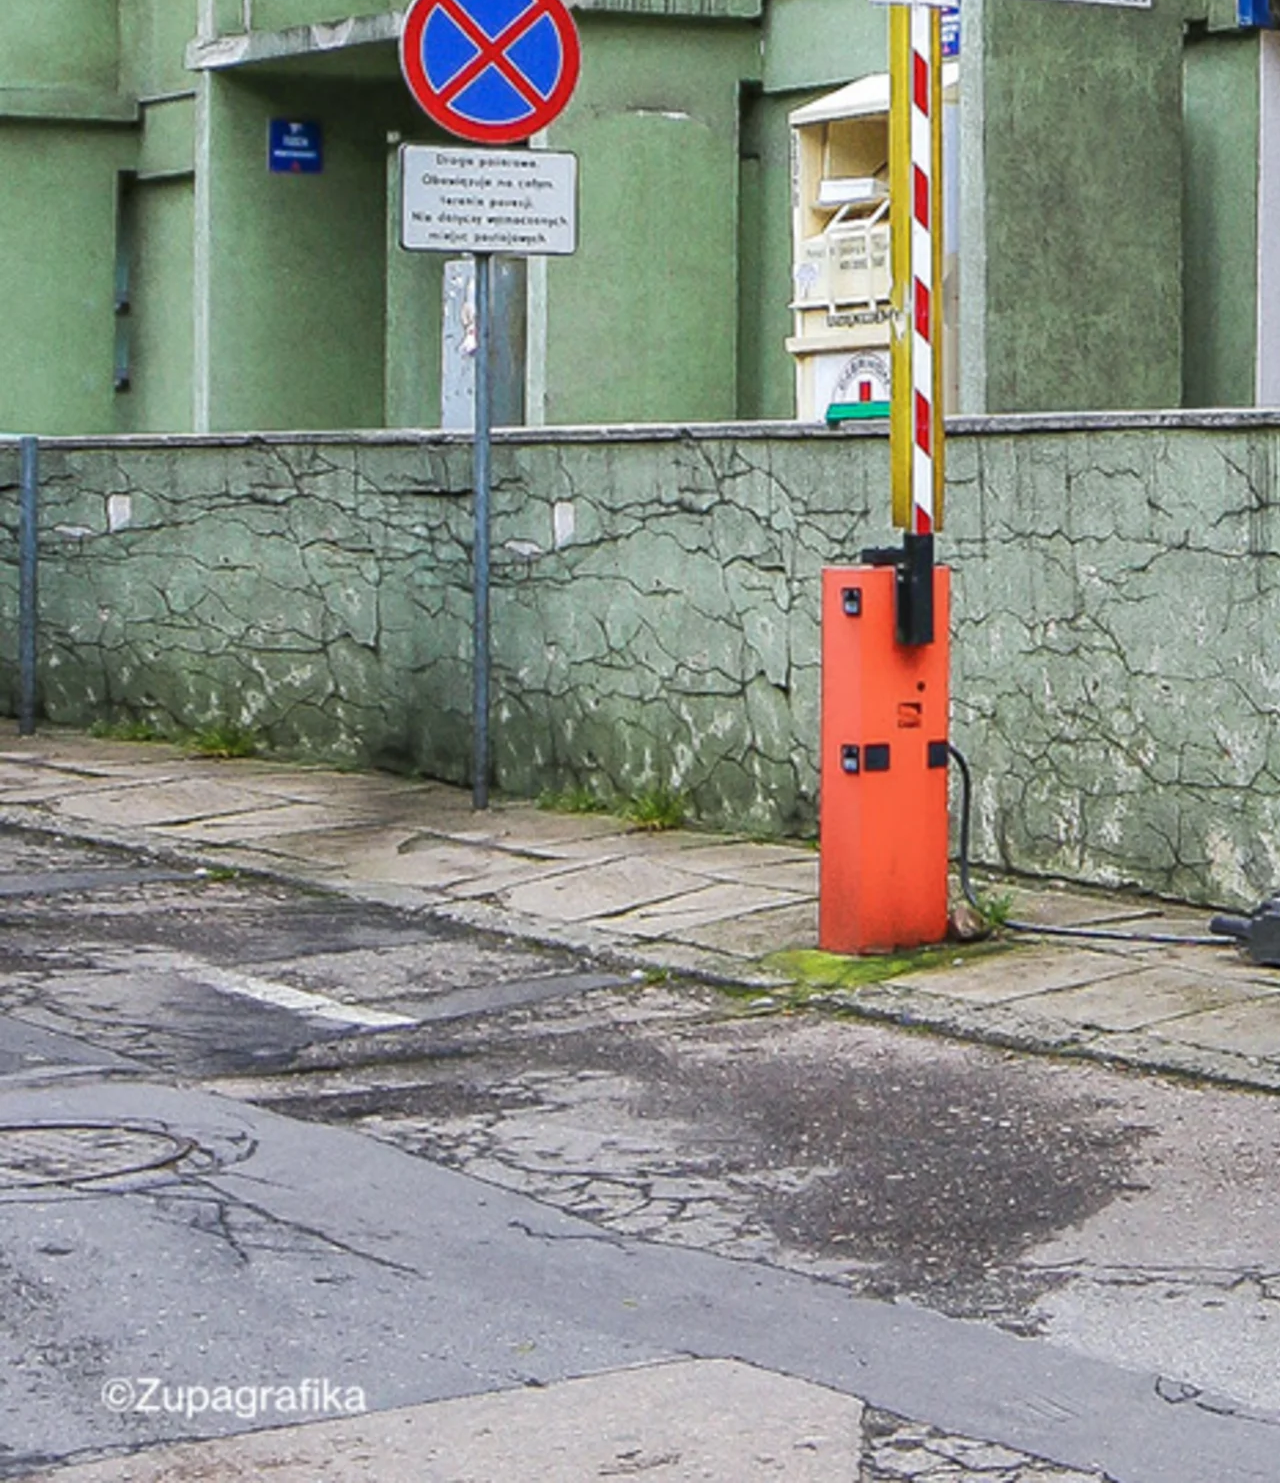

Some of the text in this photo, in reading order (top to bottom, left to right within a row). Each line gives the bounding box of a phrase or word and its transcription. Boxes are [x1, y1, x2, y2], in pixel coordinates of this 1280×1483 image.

[436, 154, 473, 169] Droga
[497, 179, 513, 188] na
[440, 196, 484, 207] terenie
[411, 211, 432, 222] Nie
[438, 212, 481, 226] dotyczy
